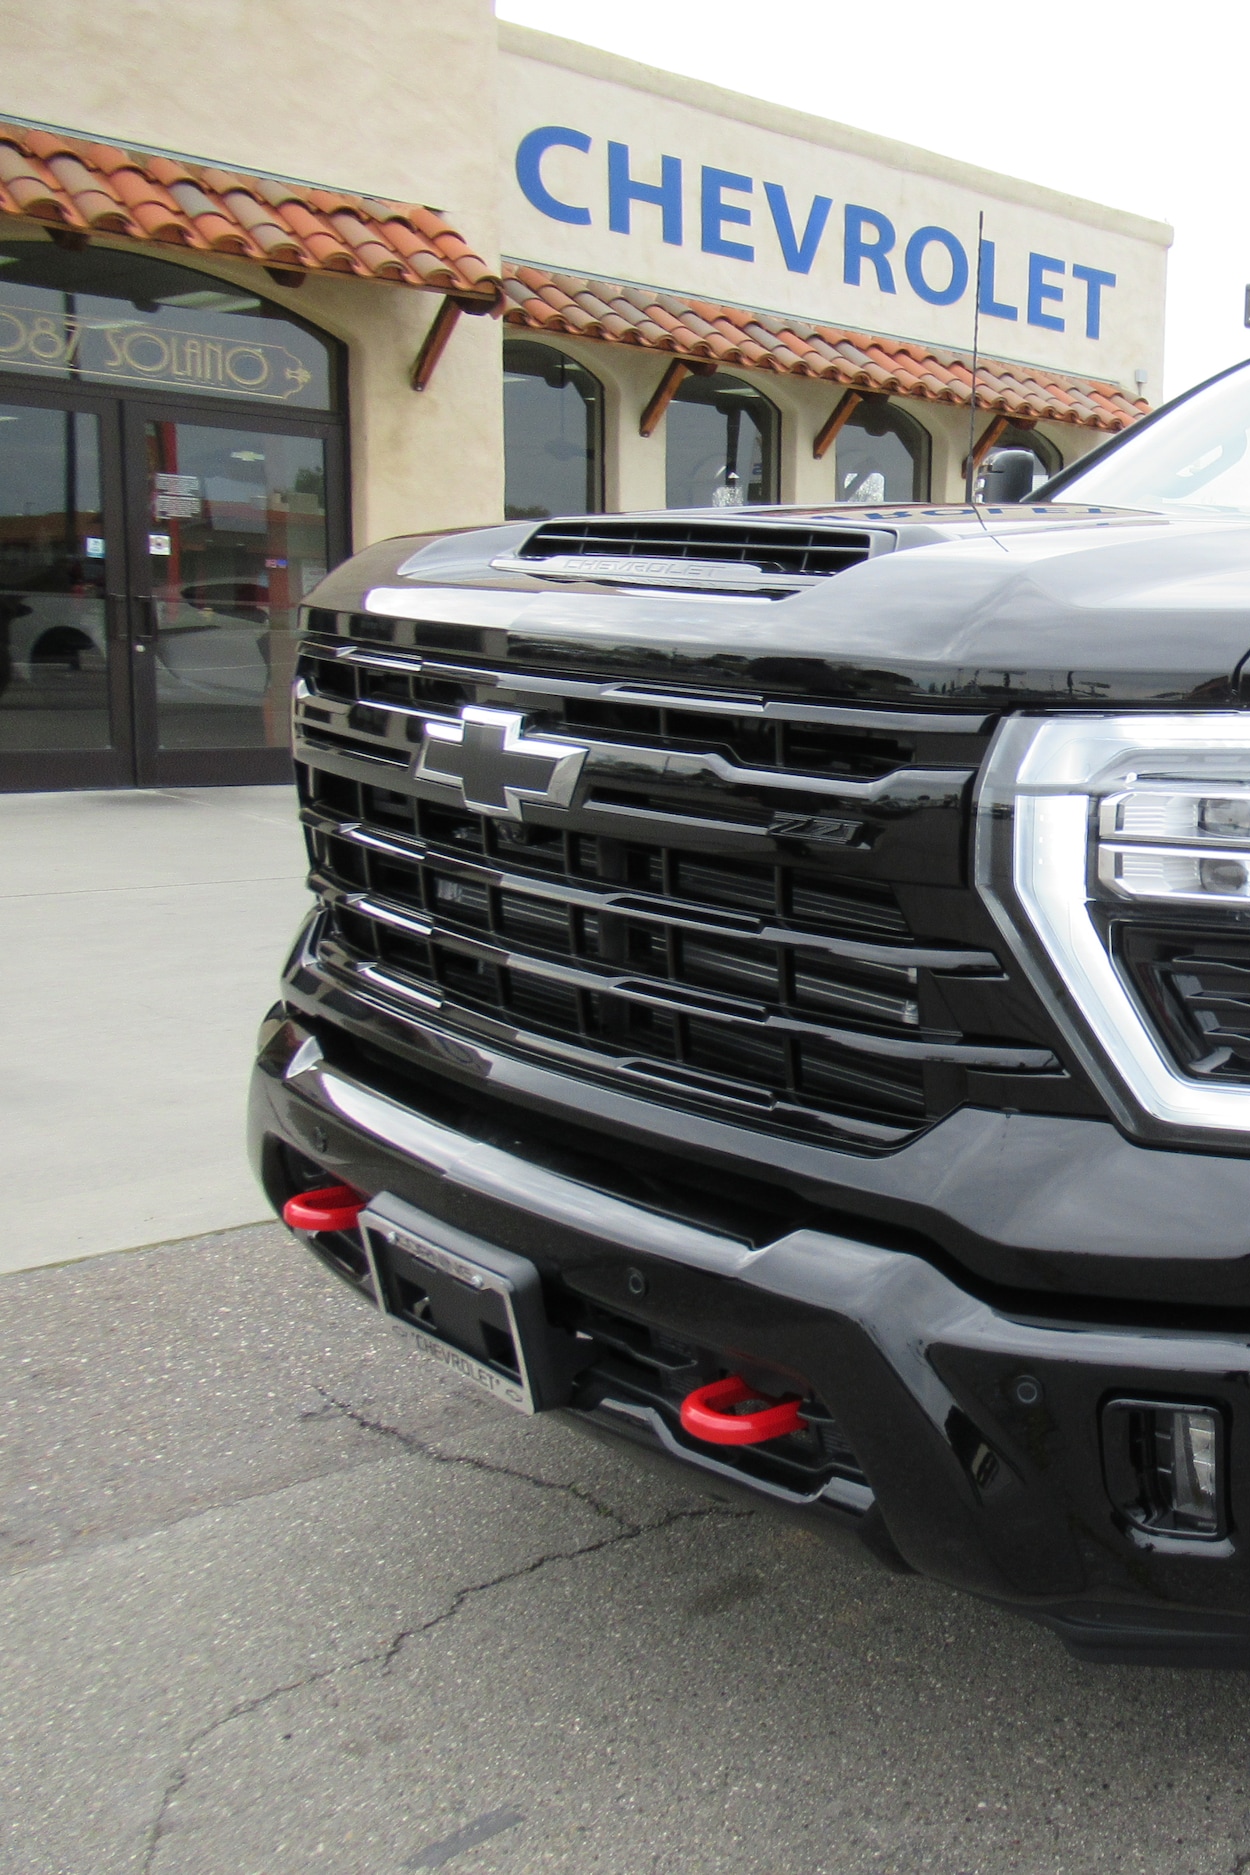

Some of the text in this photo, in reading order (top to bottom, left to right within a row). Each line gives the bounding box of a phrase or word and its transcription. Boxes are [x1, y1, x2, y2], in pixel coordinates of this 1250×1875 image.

[515, 125, 1117, 340] CHEVROLET
[105, 327, 270, 386] SOLANO
[564, 559, 726, 578] CHEVROLET
[767, 811, 863, 844] Z71
